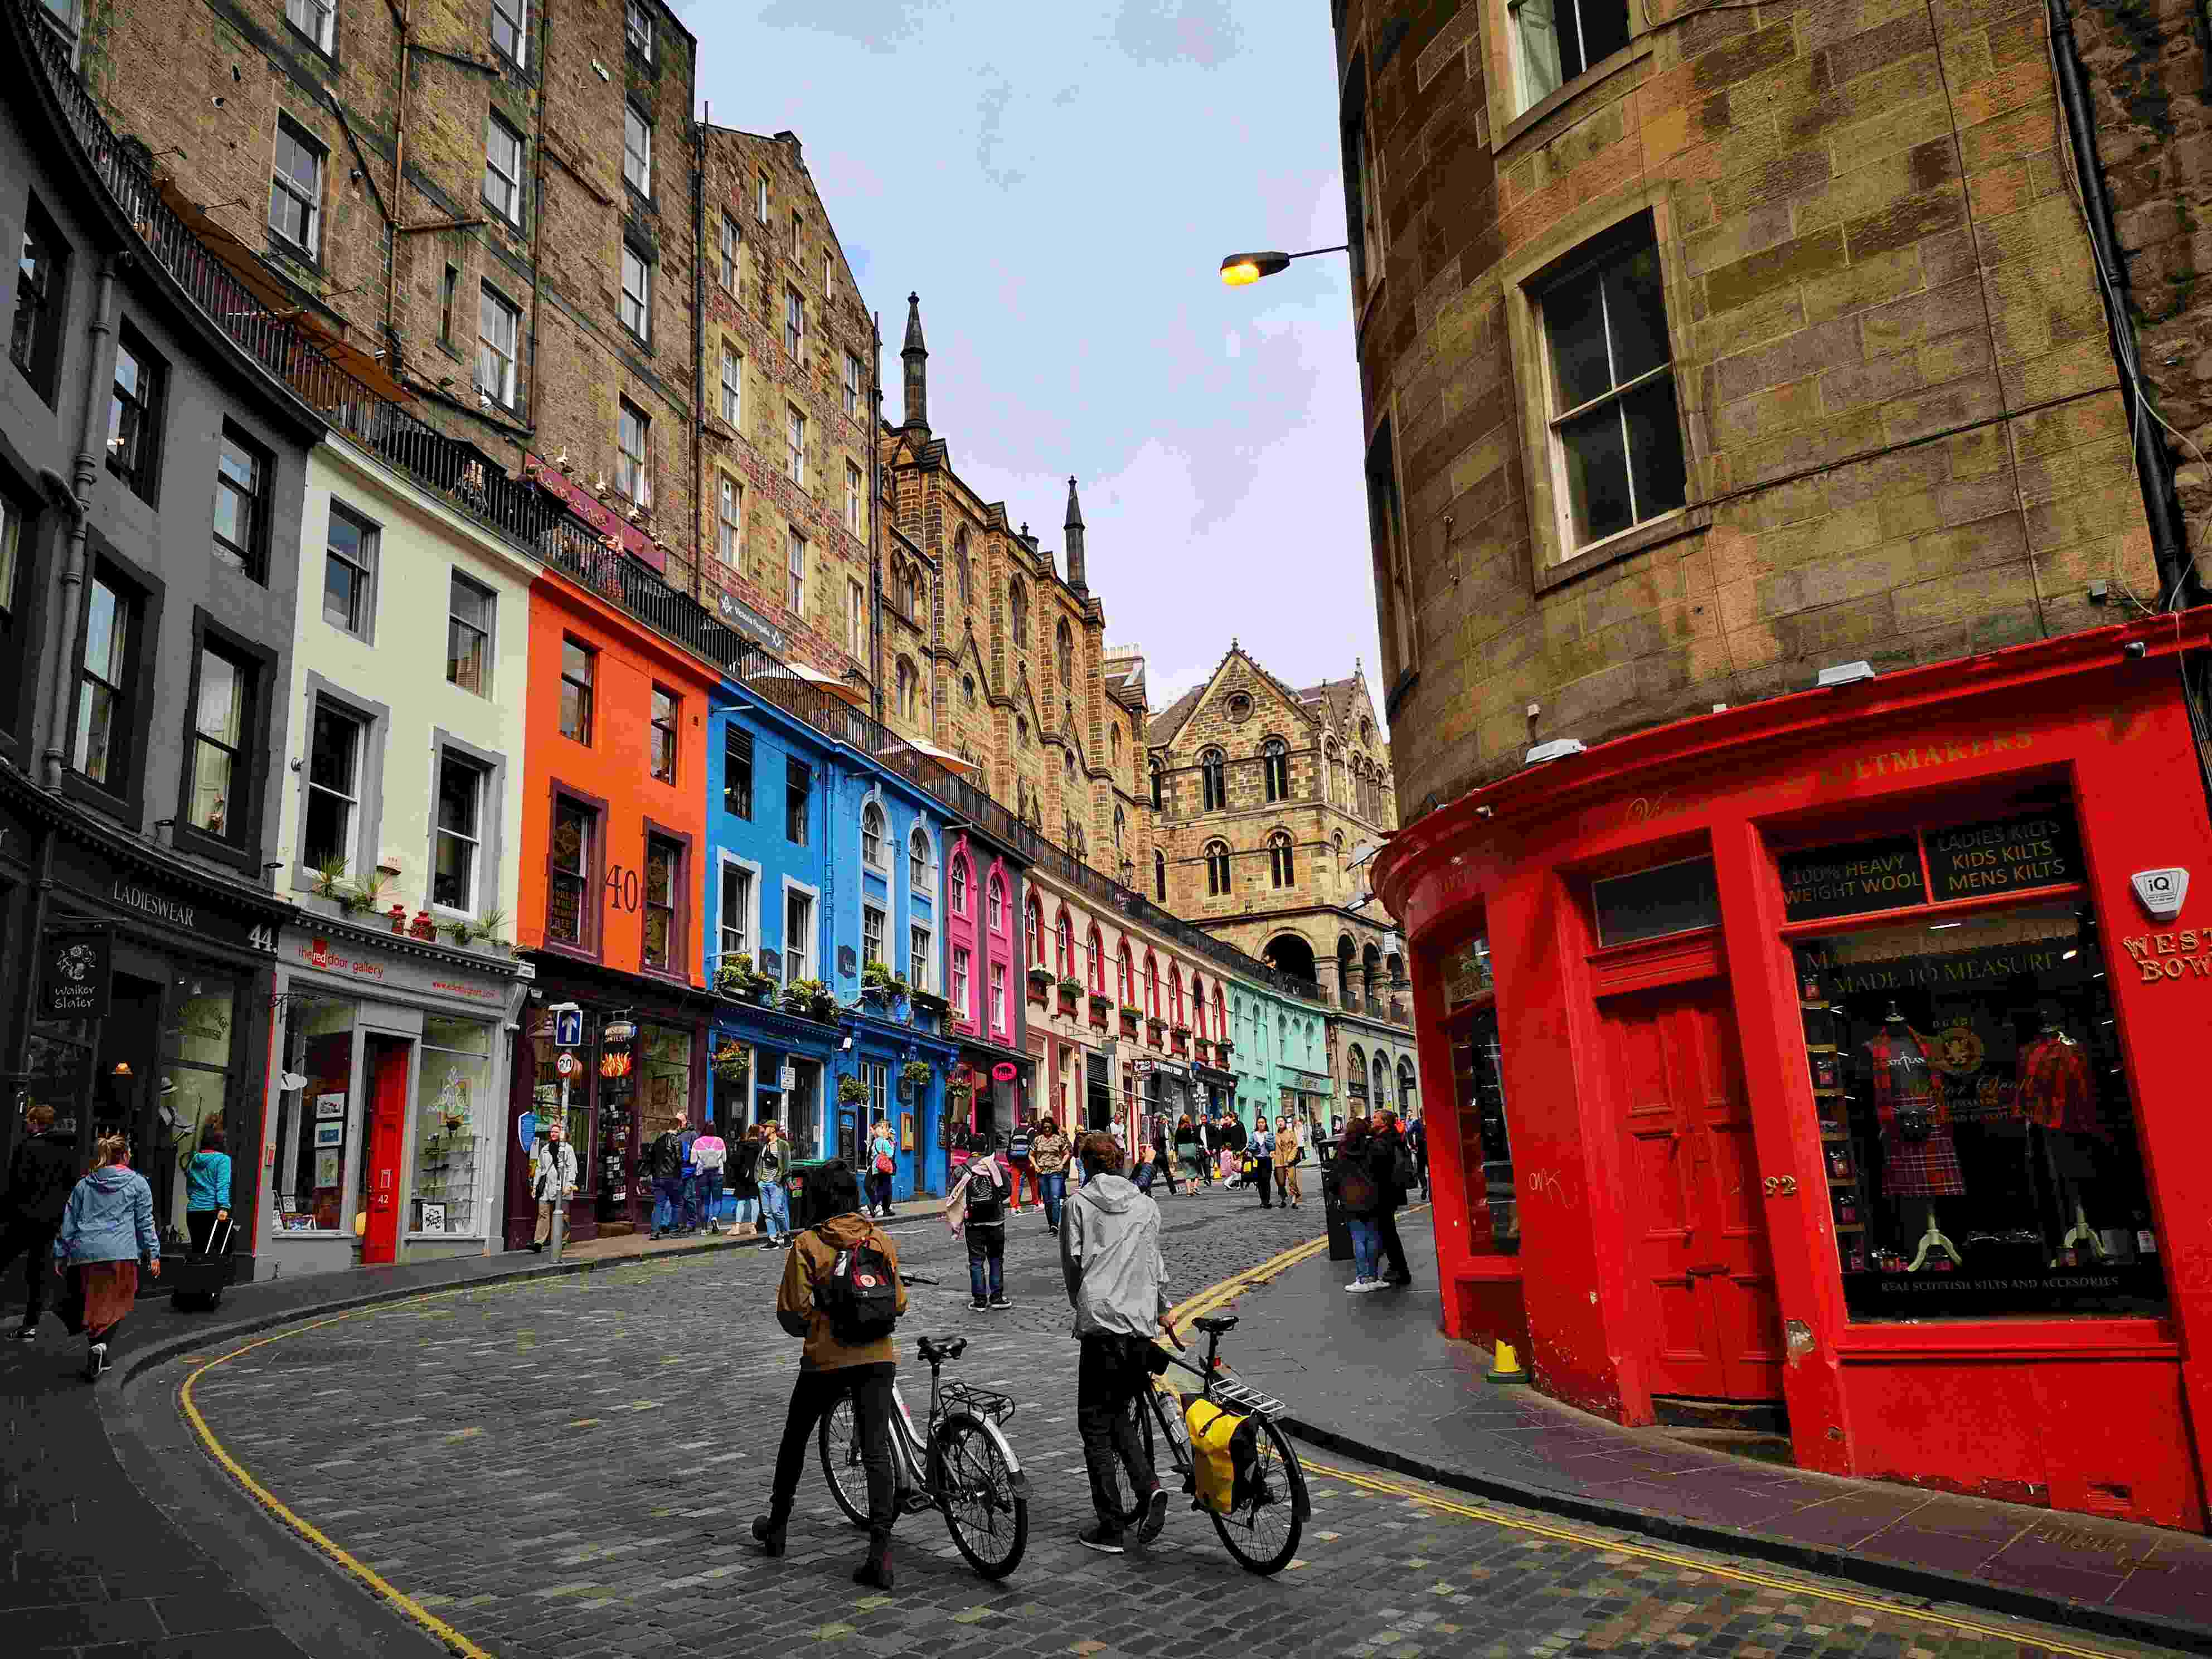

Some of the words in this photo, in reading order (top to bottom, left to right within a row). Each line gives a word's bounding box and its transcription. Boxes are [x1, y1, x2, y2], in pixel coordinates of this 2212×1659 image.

[1937, 828, 2004, 852] LADIES
[1953, 849, 1997, 870] KIDS
[2002, 840, 2052, 861] KILTS
[1792, 865, 1840, 885] 100%
[1846, 856, 1904, 879] HEAVY
[1948, 868, 2007, 892] MENS
[2013, 858, 2065, 879] KILTS
[2148, 876, 2170, 891] iQ
[605, 865, 638, 913] 40
[1783, 881, 1856, 905] WEIGHT
[1860, 870, 1923, 894] WOOL
[113, 880, 194, 928] LADIESWEAR
[298, 946, 313, 960] the
[313, 950, 327, 963] red
[327, 952, 348, 969] door
[352, 961, 384, 979] gallery
[1833, 971, 1900, 993] MADE
[1908, 965, 1938, 986] TO
[559, 1059, 572, 1071] 20
[377, 1194, 389, 1205] 42
[1765, 1175, 1798, 1196] 92
[1881, 1280, 1909, 1292] REAL
[1913, 1279, 1971, 1291] SCOTTISH
[1974, 1279, 2008, 1289] KILTS
[2011, 1279, 2038, 1289] AND
